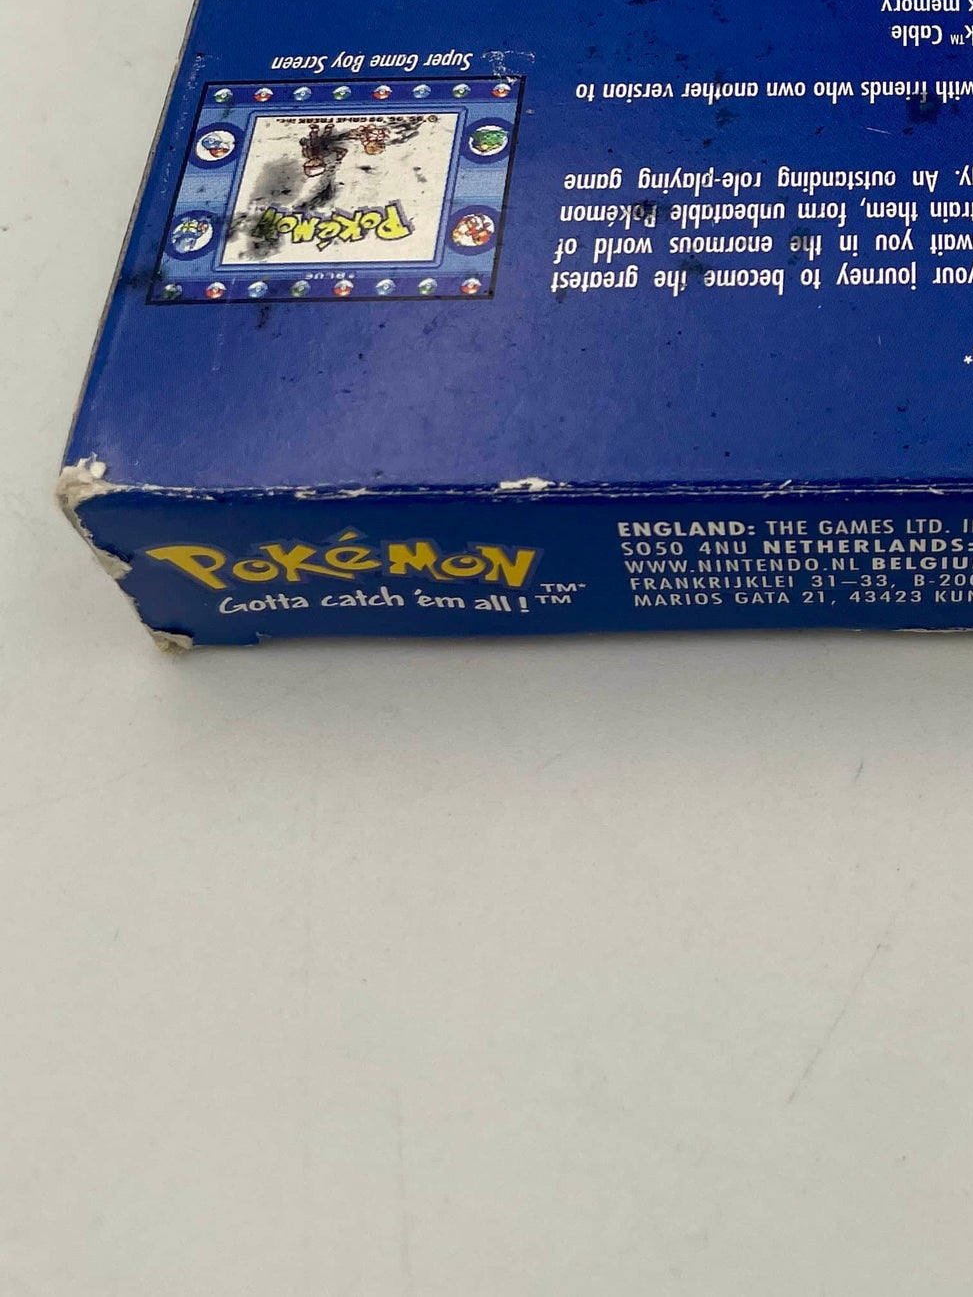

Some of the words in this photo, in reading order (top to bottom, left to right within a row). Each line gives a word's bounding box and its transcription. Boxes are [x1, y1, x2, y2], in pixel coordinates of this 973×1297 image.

[270, 55, 328, 73] Screen
[330, 50, 365, 72] Boy
[369, 53, 419, 72] Game
[422, 48, 473, 71] Super
[563, 167, 622, 190] game
[637, 165, 761, 197] role-playing
[777, 164, 896, 196] outstanding
[911, 170, 939, 192] An
[549, 264, 638, 293] greatest
[703, 268, 784, 295] become
[800, 267, 821, 290] to
[835, 260, 916, 290] journey
[617, 520, 755, 537] ENGLAND:
[765, 519, 807, 535] THE
[818, 518, 894, 535] GAMES
[906, 518, 950, 534] LTD.
[698, 540, 746, 555] 4NU
[762, 537, 973, 554] NETHERLANDS:
[623, 557, 859, 573] WWW.NINTENDO.NL
[629, 575, 793, 590] FRANKRIJKLEI
[219, 592, 305, 615] Gotta
[321, 586, 405, 607] catch
[634, 592, 722, 607] MARIOS
[734, 591, 789, 604] GATA
[801, 590, 835, 605] 21,
[848, 589, 921, 603] 43423
